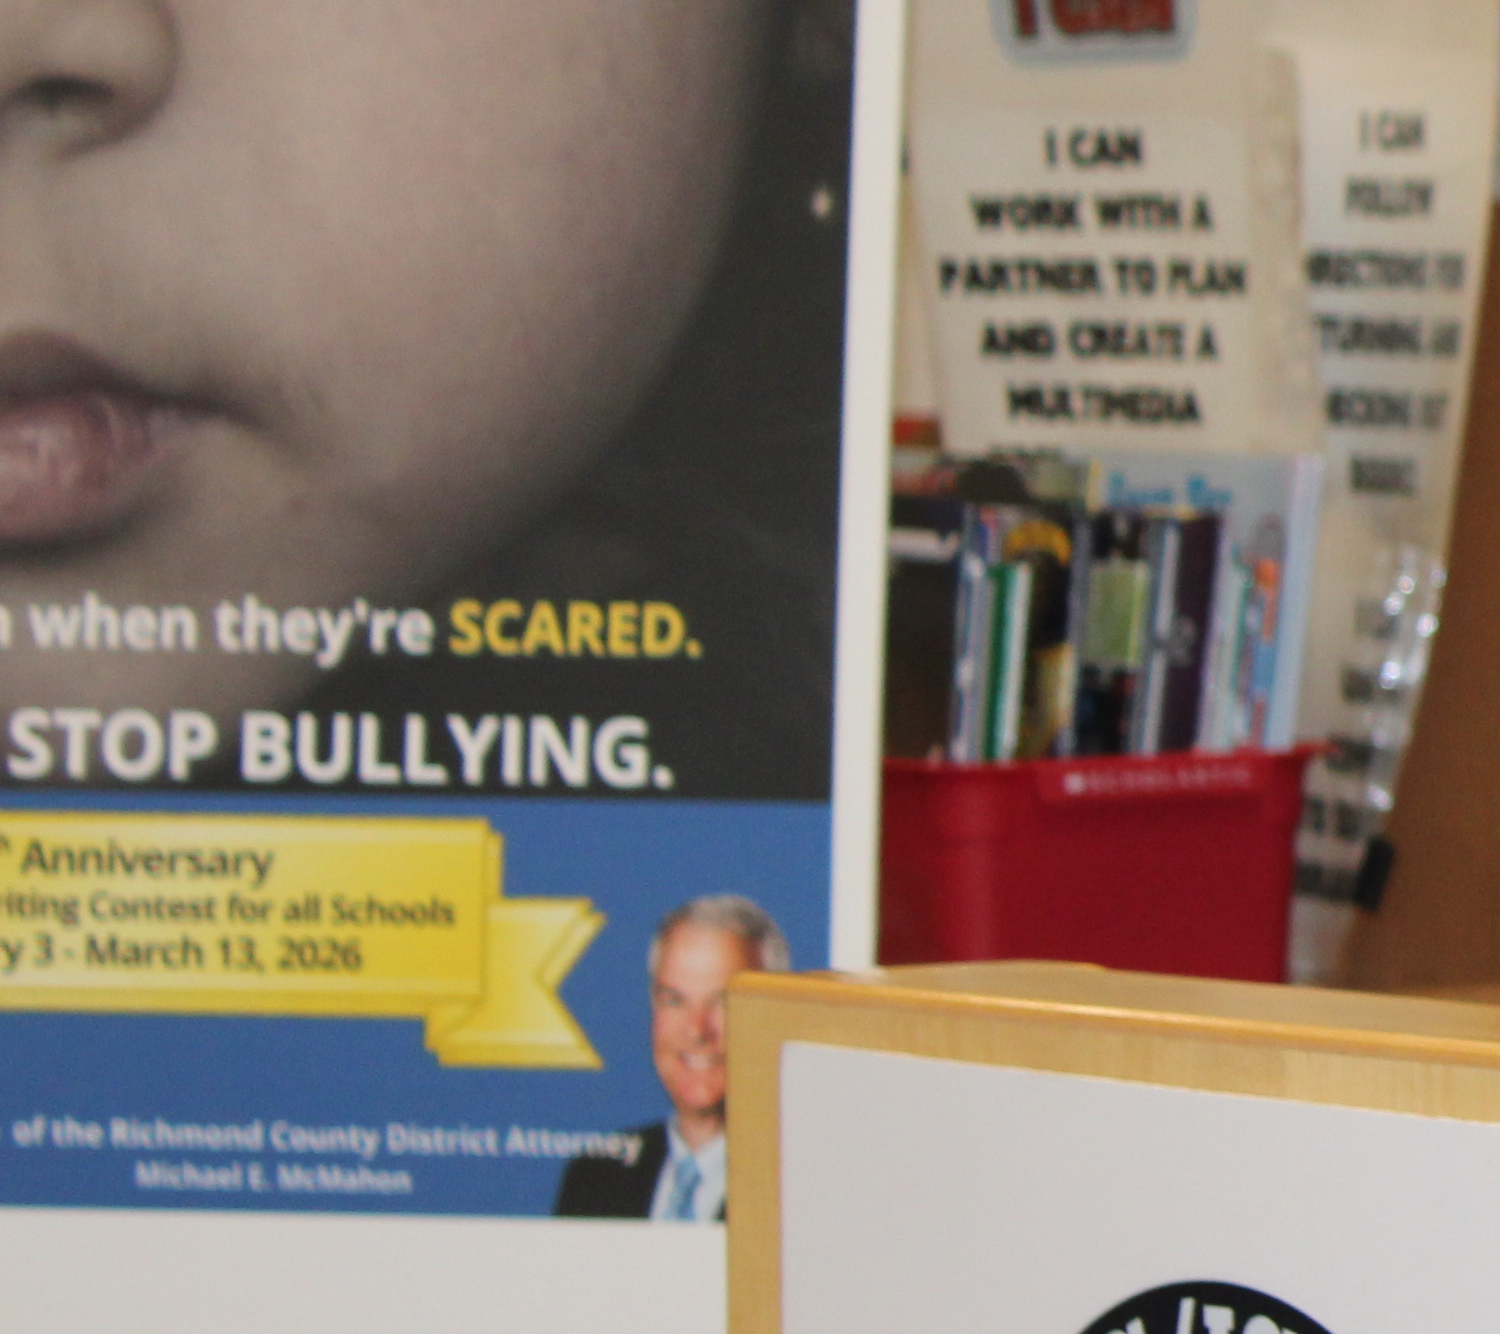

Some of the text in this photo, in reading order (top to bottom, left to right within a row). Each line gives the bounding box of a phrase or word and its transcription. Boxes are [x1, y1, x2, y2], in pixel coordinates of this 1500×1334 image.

[1044, 128, 1142, 166] I CAN
[971, 194, 1214, 231] WORK WITH A
[940, 257, 1247, 296] PARTNER TO PLAN
[982, 322, 1217, 359] AND CREATE A
[1007, 385, 1204, 422] MULTIMEDIA
[28, 592, 197, 651] when
[214, 593, 435, 667] they're
[449, 599, 703, 658] SCARED.
[7, 707, 675, 789] STOP BULLYING.
[21, 838, 274, 888] Anniversary
[0, 889, 456, 928] iting Contest for all Schools
[32, 934, 54, 967] 3
[85, 934, 204, 968] March
[219, 937, 266, 973] 13,
[277, 939, 364, 972] 2026
[12, 1114, 643, 1166] of the Richmond County District Attorney
[134, 1160, 413, 1195] Michael E. McMahon
